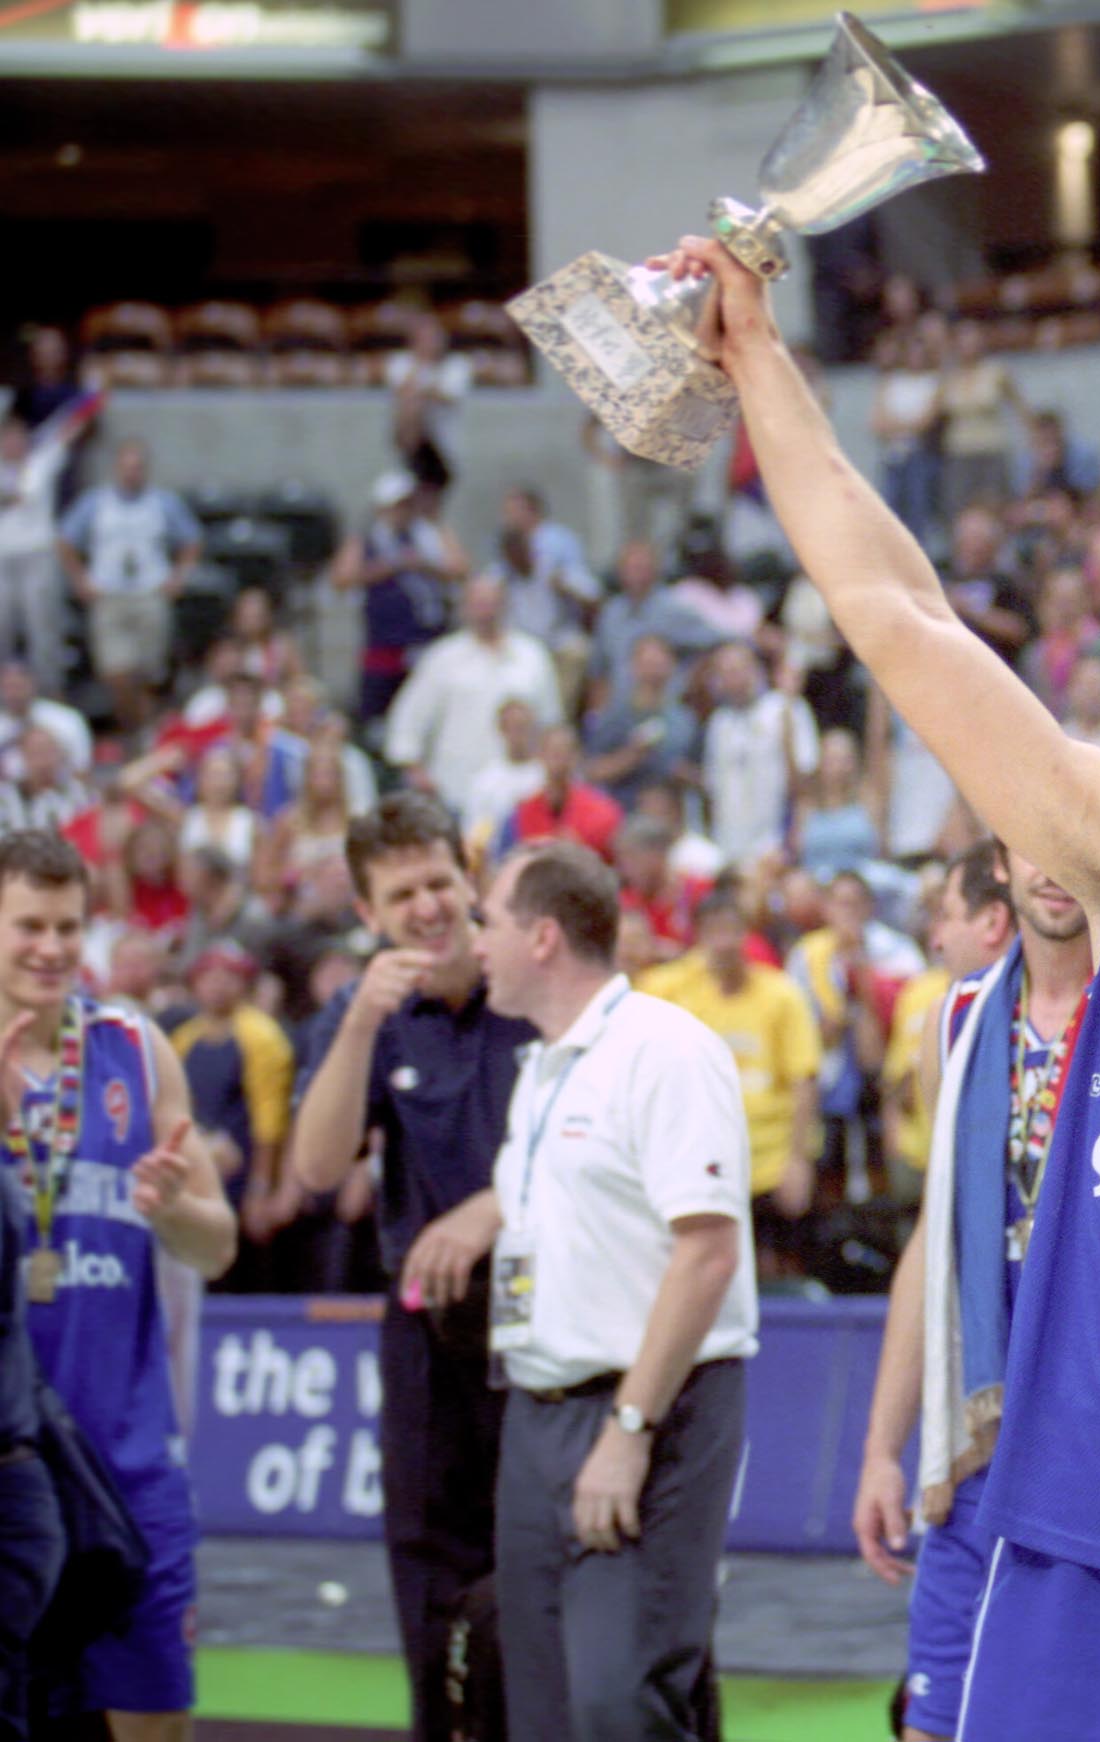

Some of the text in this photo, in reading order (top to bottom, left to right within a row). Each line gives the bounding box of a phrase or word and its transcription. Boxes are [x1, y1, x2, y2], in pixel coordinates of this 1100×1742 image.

[105, 1077, 130, 1145] 9
[215, 1328, 337, 1418] the
[246, 1424, 337, 1515] of
